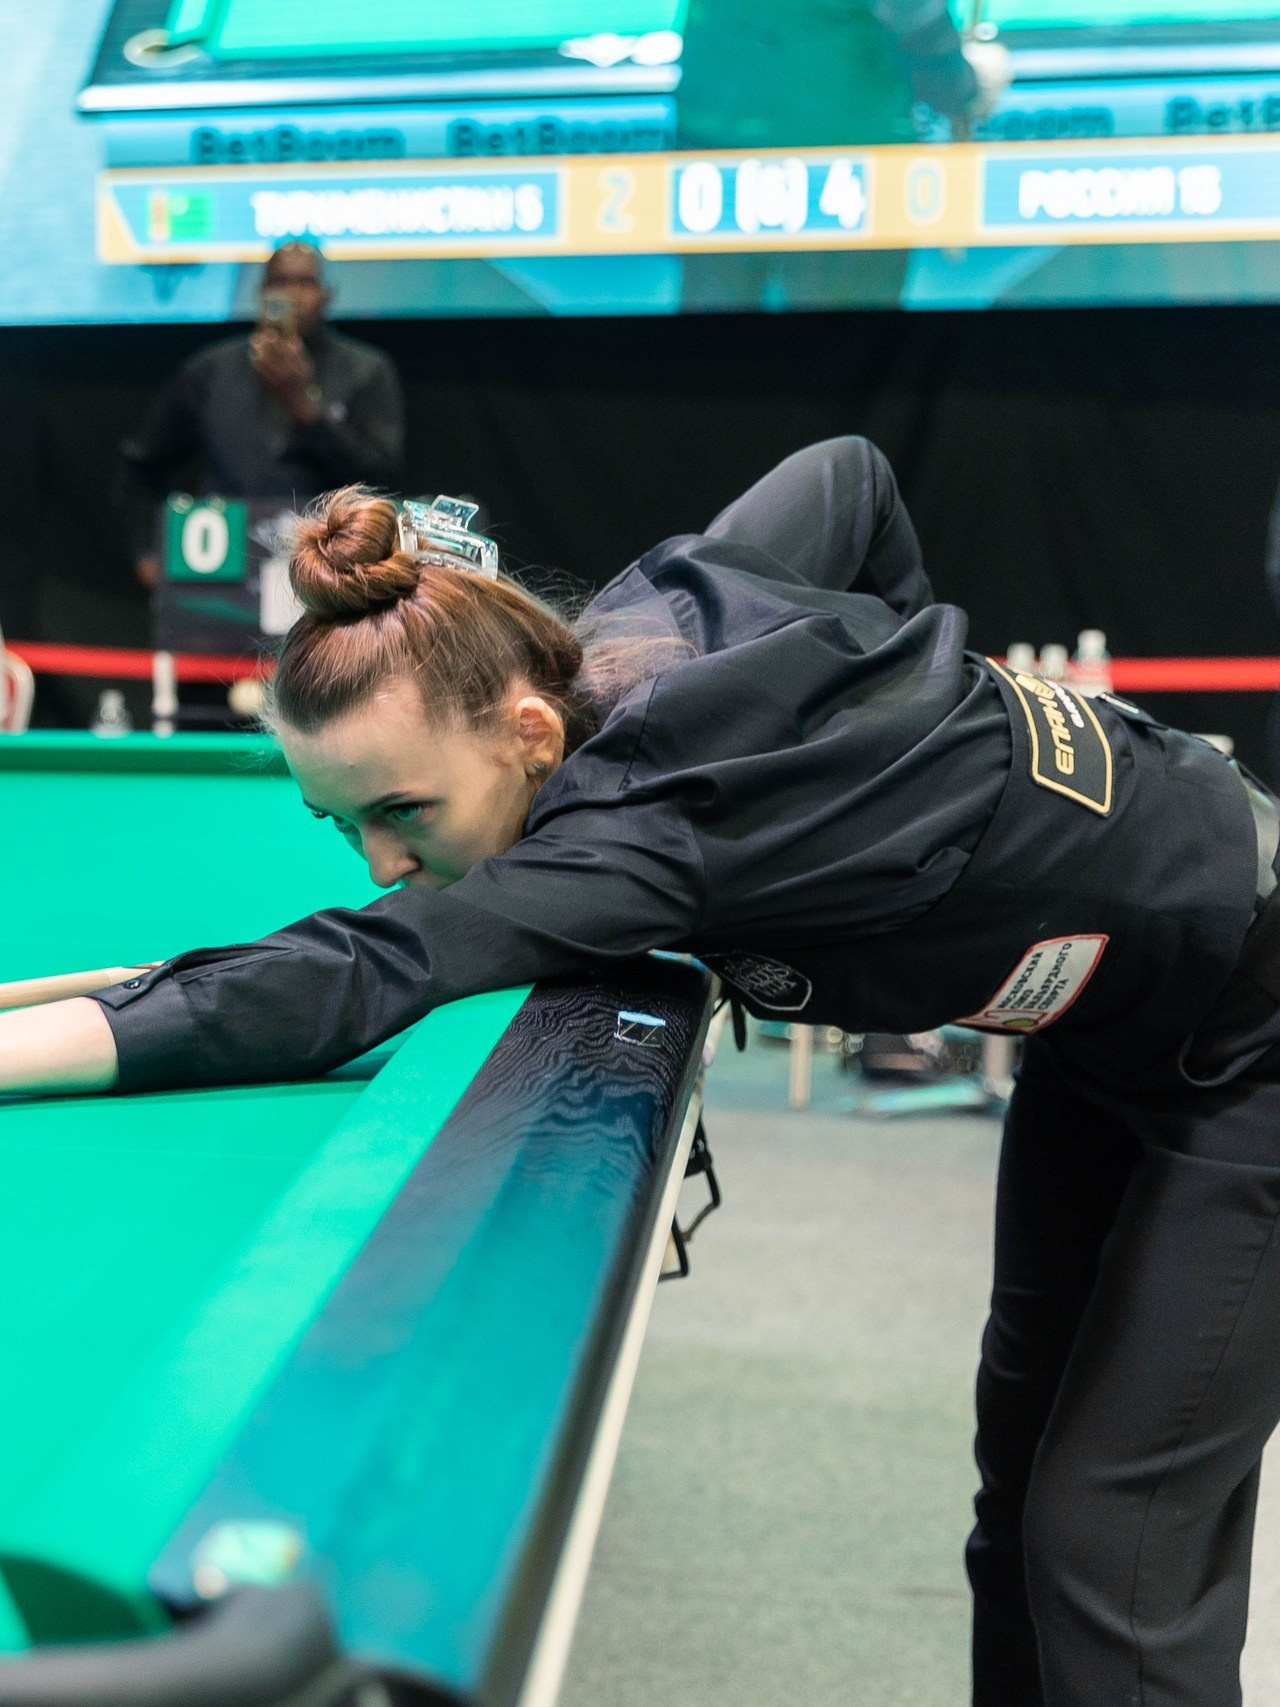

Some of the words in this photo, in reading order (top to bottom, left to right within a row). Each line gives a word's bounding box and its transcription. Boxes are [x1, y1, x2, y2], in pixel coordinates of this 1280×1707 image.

[596, 165, 638, 234] 2
[679, 161, 722, 234] 0
[819, 157, 867, 230] 4
[903, 156, 946, 227] 0
[181, 507, 229, 574] 0
